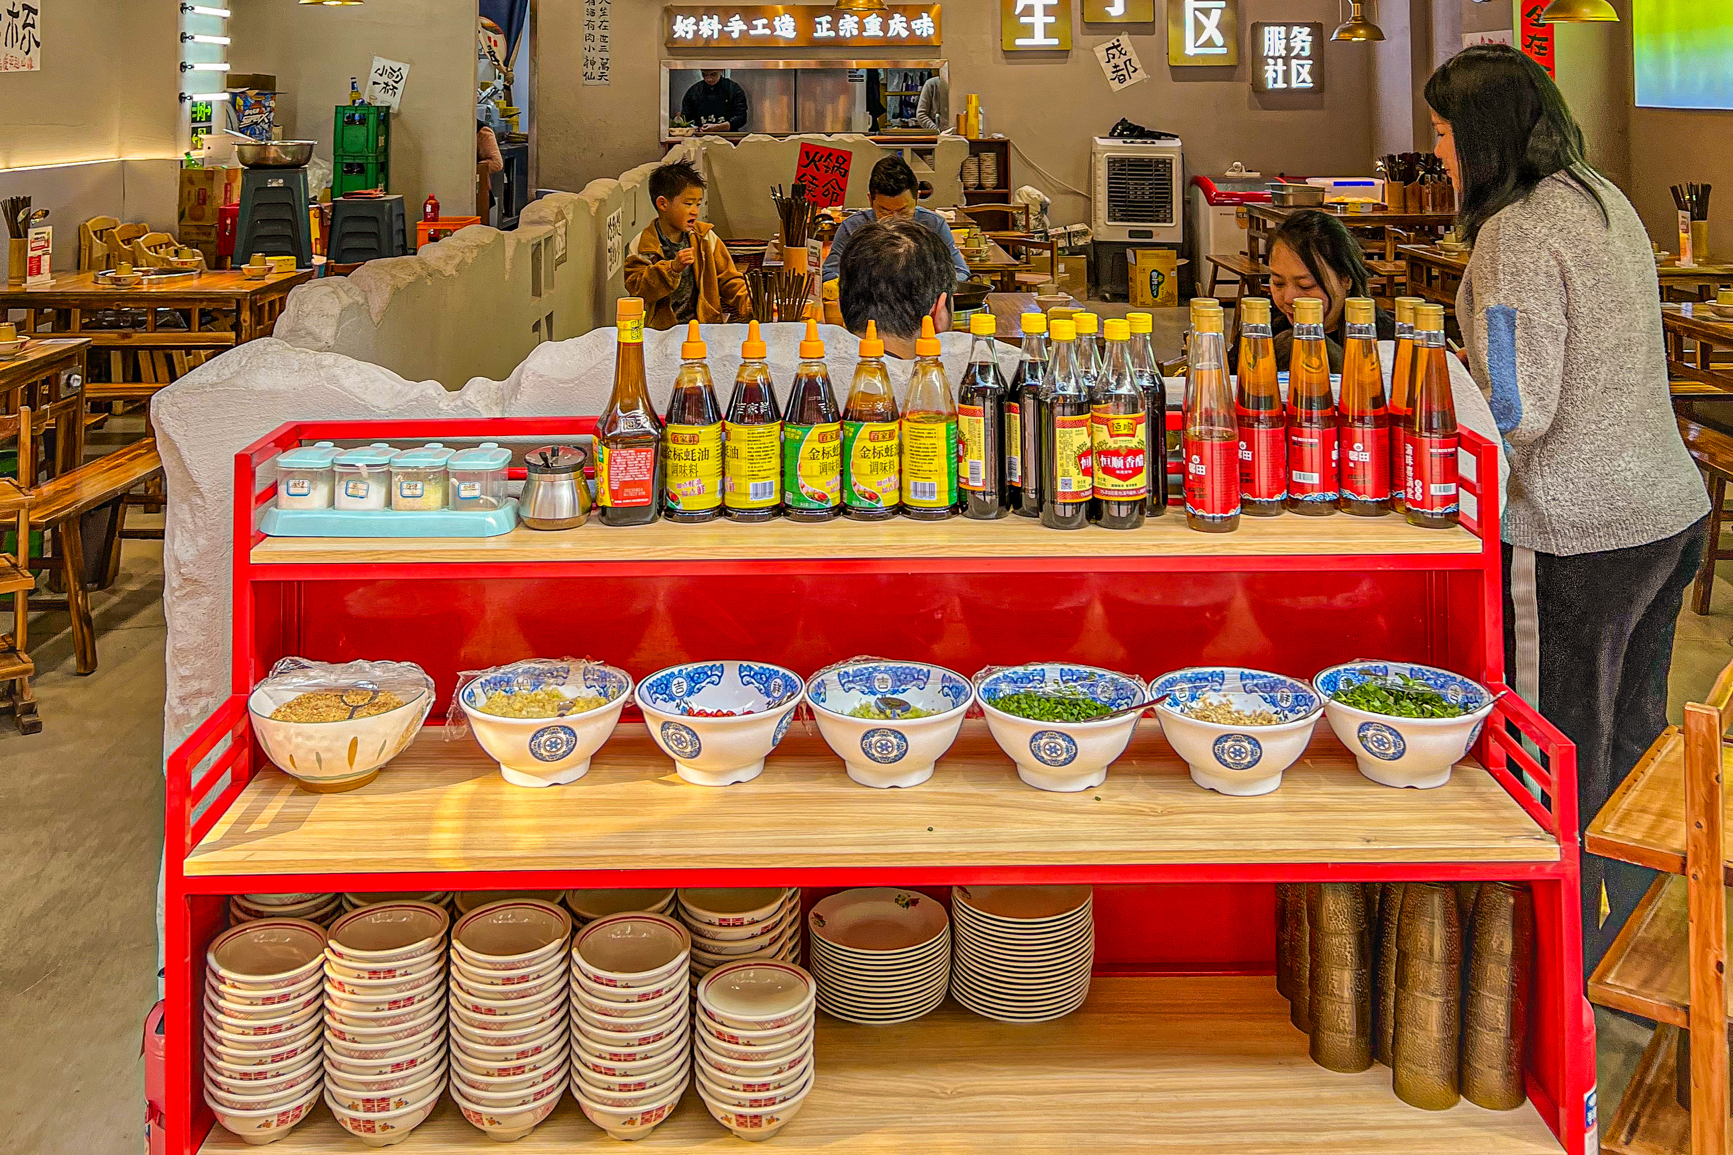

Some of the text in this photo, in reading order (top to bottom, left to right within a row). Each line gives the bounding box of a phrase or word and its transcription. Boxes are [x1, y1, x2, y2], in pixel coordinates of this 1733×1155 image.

[672, 12, 936, 40] 好料手工造 正宗重庆味
[1263, 26, 1313, 58] 服务
[1104, 38, 1139, 85] 成都
[1264, 58, 1315, 90] 社区
[801, 150, 849, 179] 火锅
[796, 172, 845, 207] 续命
[662, 446, 710, 462] 金标蚝油
[1099, 453, 1145, 469] 恒顺香醋
[672, 462, 698, 478] 调味料
